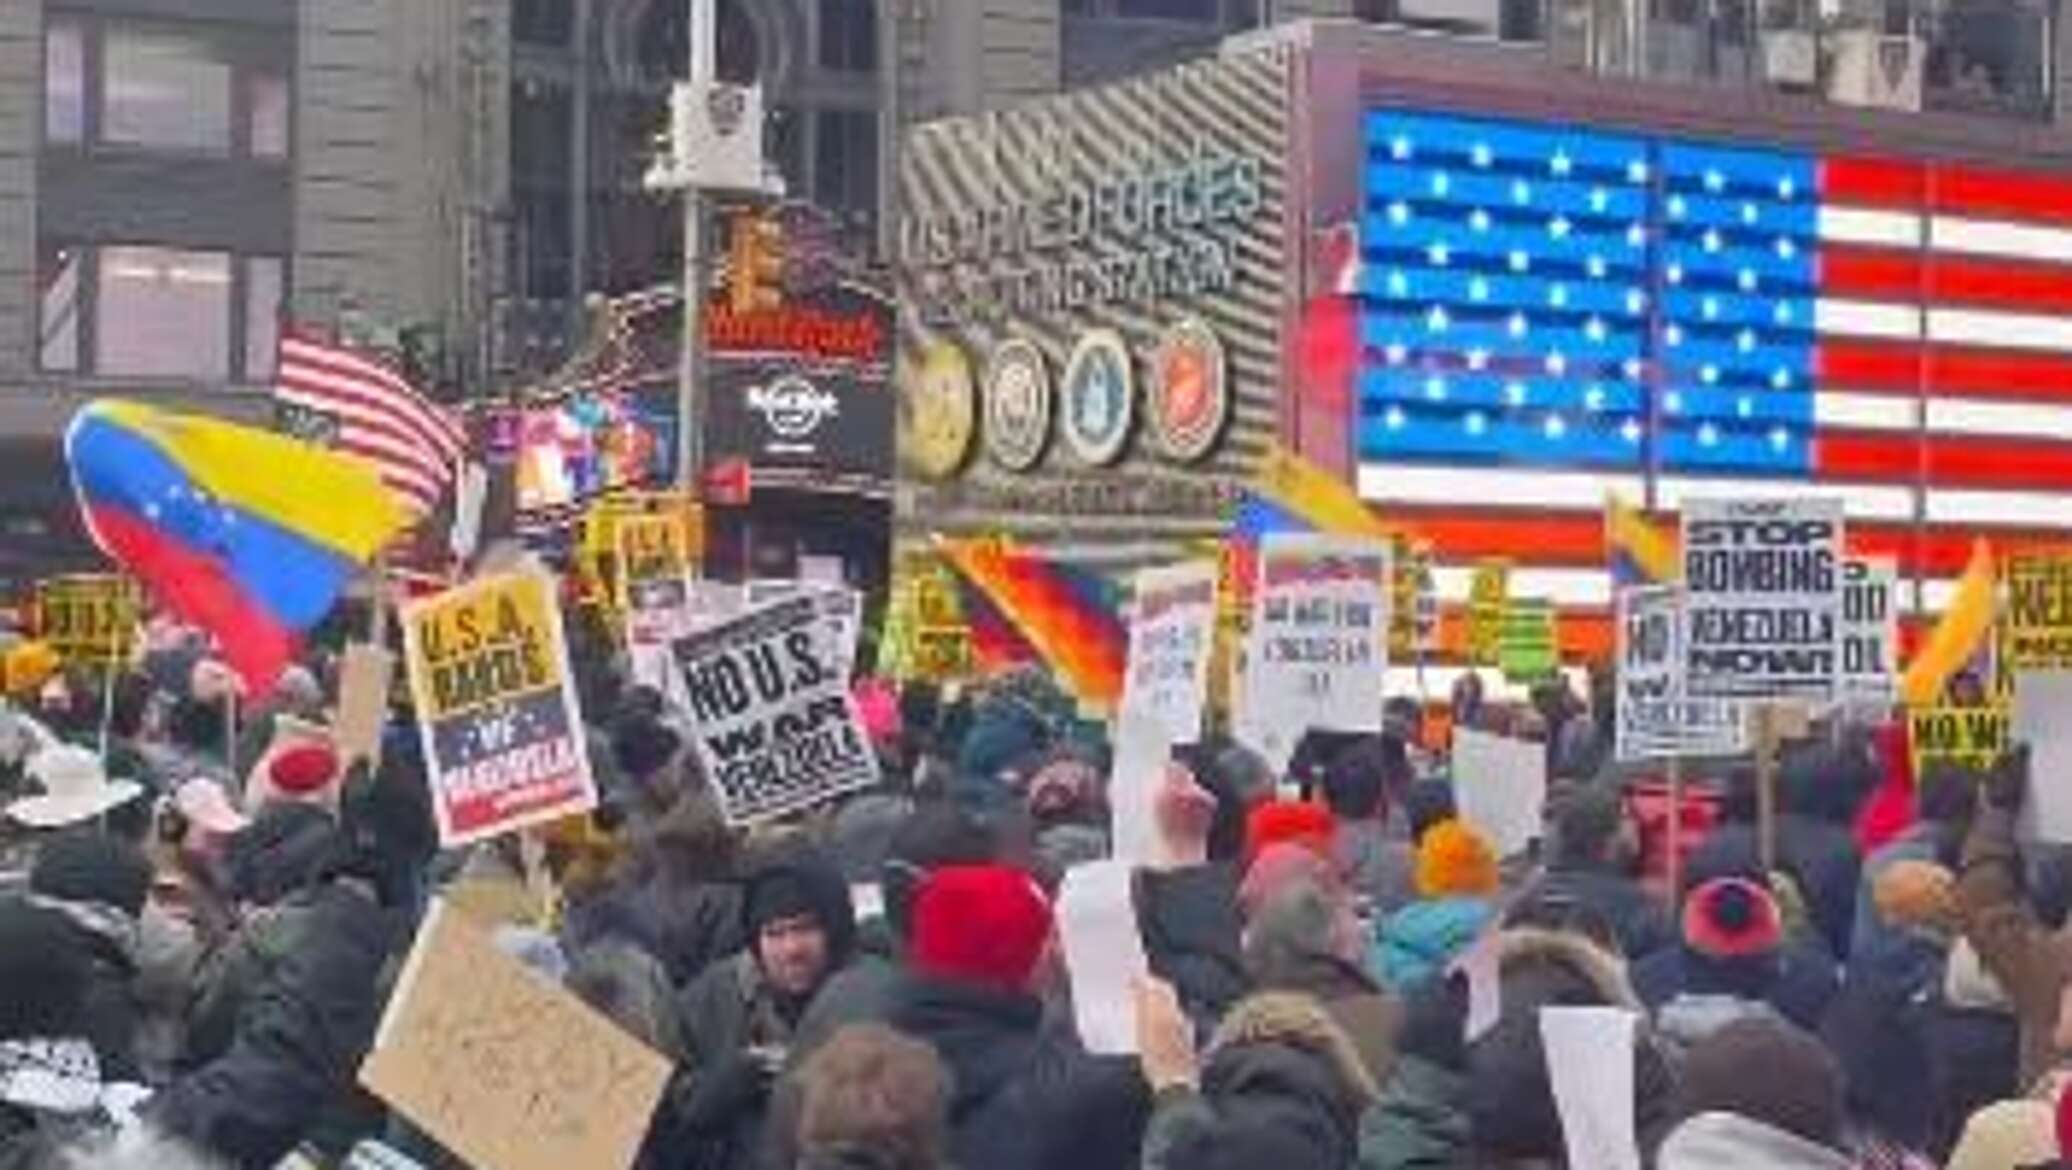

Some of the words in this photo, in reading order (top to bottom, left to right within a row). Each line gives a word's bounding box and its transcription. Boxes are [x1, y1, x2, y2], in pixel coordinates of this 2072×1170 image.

[1686, 520, 1834, 545] STOP
[1686, 551, 1834, 592] BOMBING
[1690, 609, 1833, 645] VENEZUELA
[685, 654, 749, 722] NO
